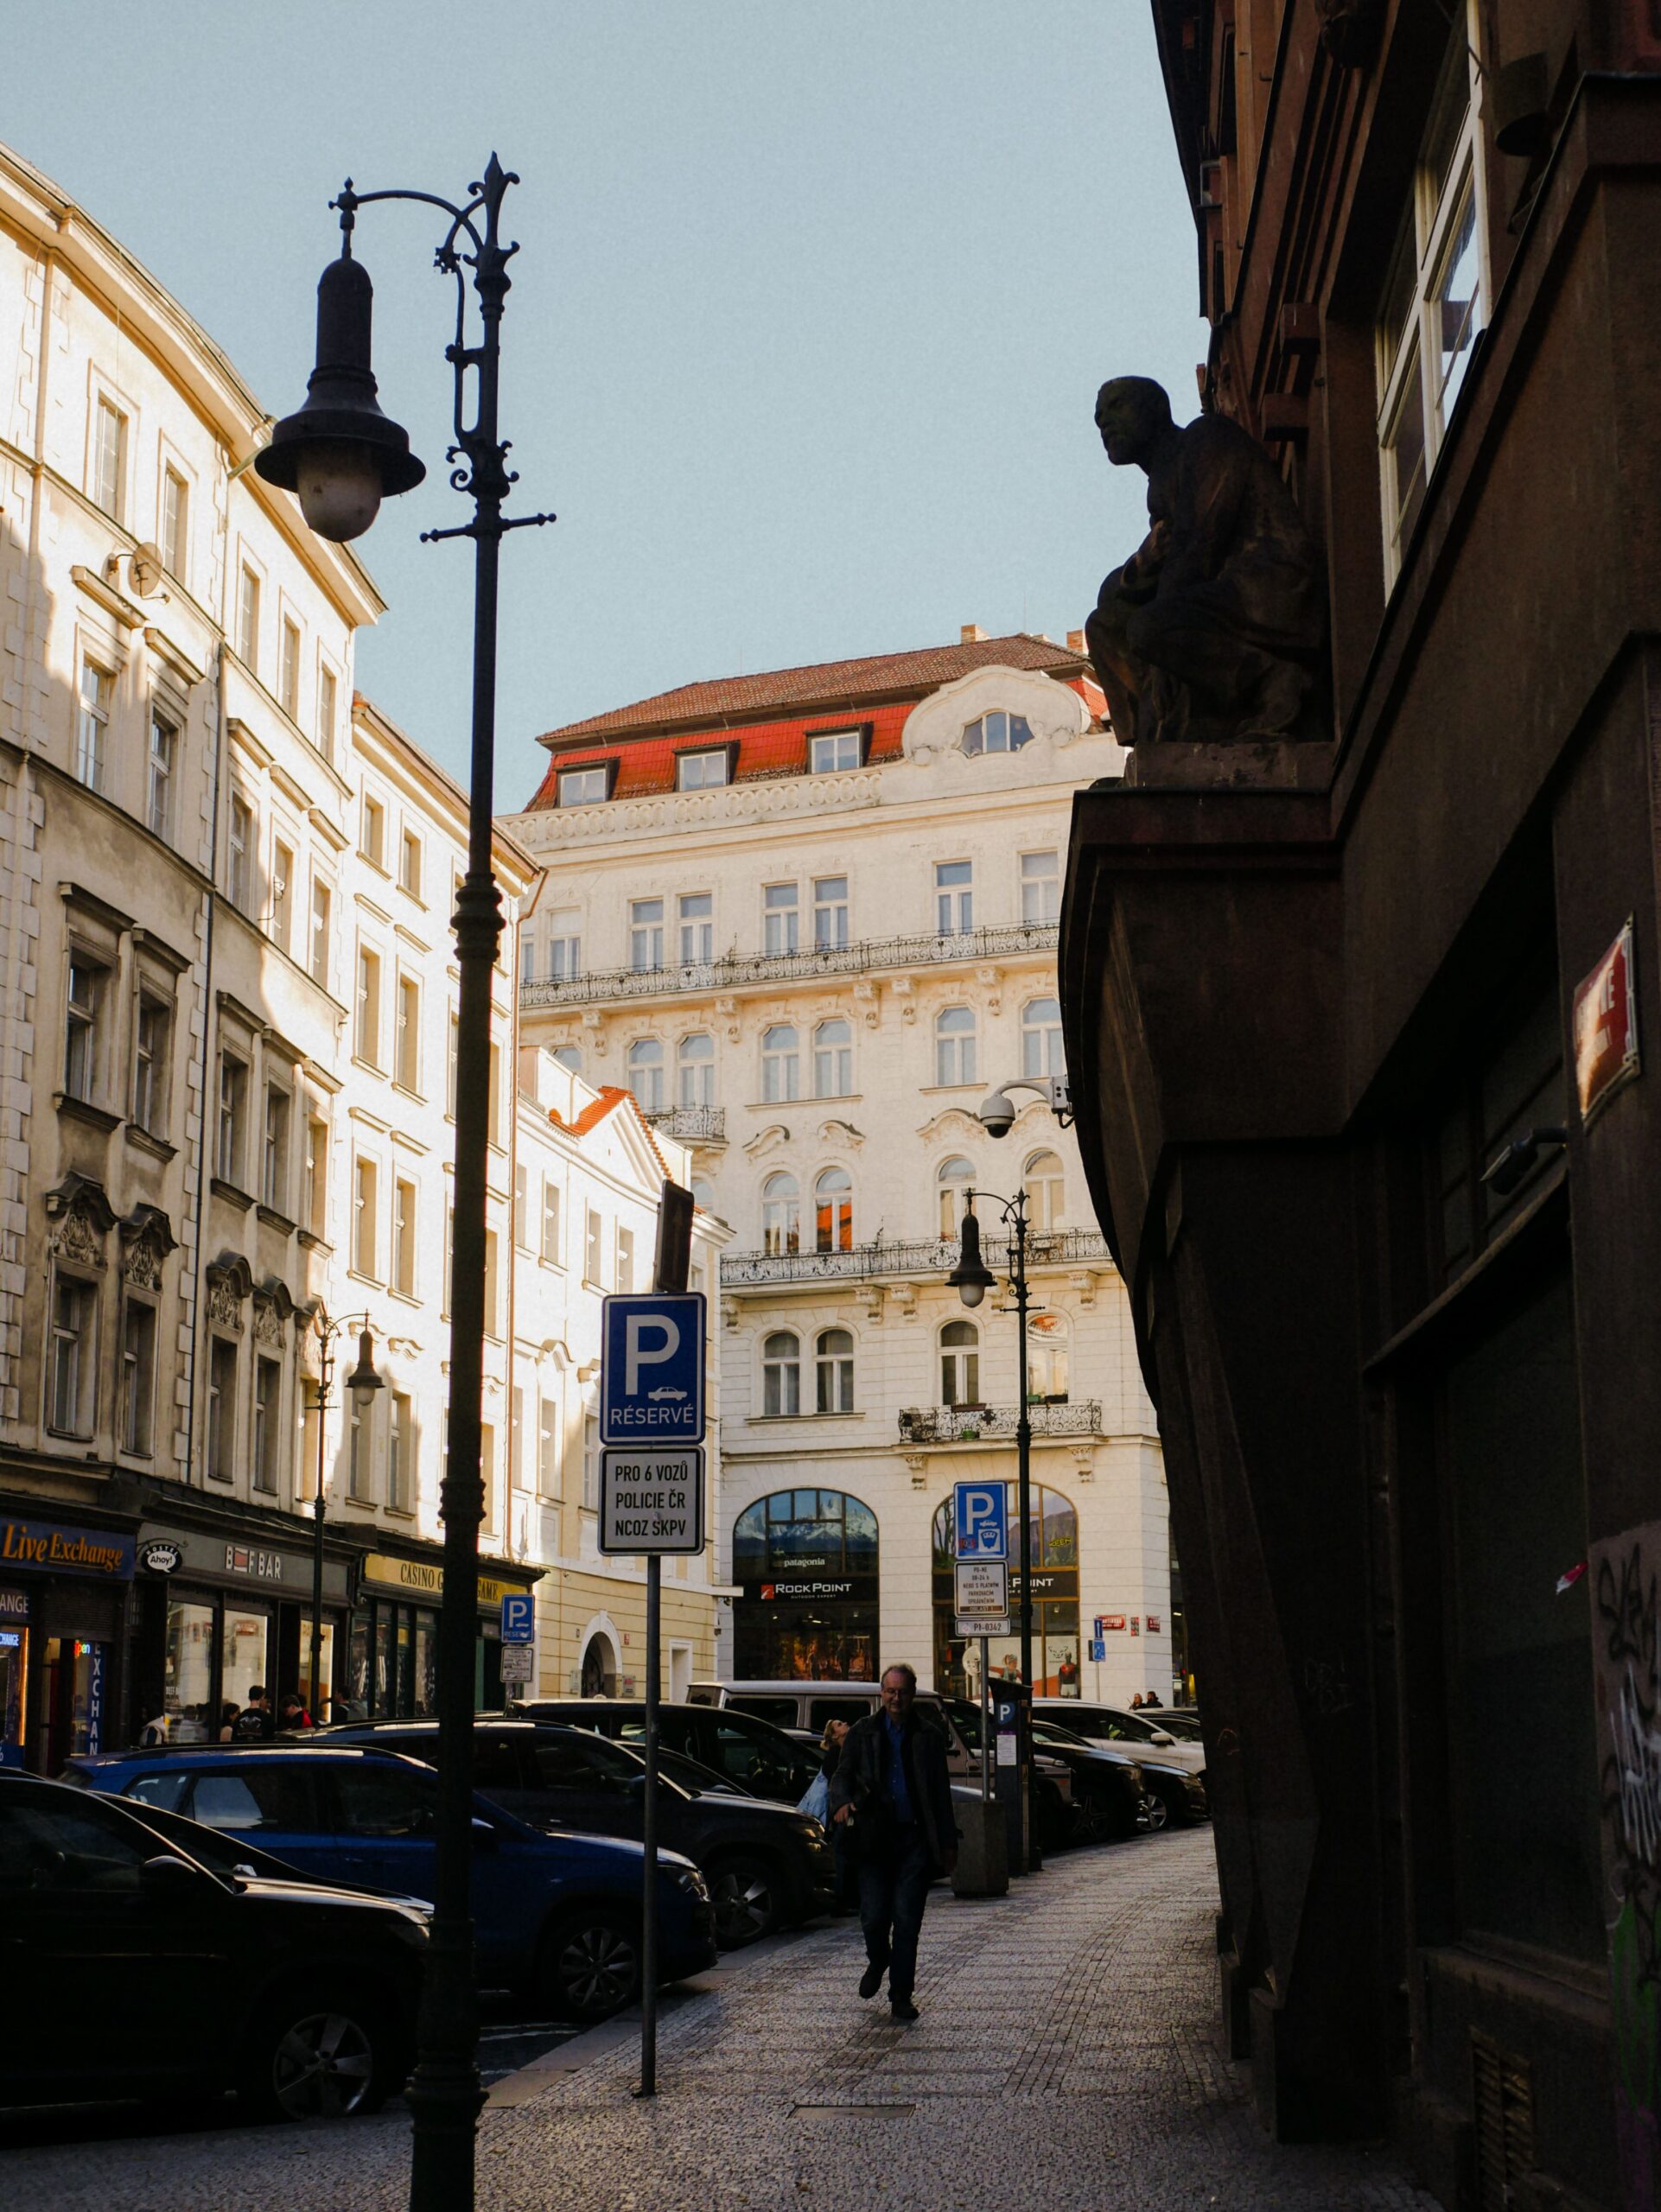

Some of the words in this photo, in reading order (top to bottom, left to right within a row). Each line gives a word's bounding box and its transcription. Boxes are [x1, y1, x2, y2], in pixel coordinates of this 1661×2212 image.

[625, 1313, 681, 1396] P
[610, 1403, 695, 1426] RÉSERVÉ
[614, 1465, 640, 1482] PRO
[644, 1464, 652, 1481] 6
[656, 1460, 689, 1481] VOZŮ
[615, 1491, 665, 1510] POLICIE
[668, 1488, 685, 1509] ČR
[965, 1491, 995, 1535] P
[614, 1521, 649, 1537] NCOZ
[652, 1519, 686, 1536] SKPV
[2, 1522, 48, 1563] Live
[48, 1533, 124, 1573] Exchange
[145, 1545, 179, 1556] HOSTEL
[150, 1554, 173, 1566] Ahoy!
[258, 1552, 282, 1580] BAR
[784, 1557, 826, 1567] patagonia
[400, 1563, 435, 1588] CASINO
[1012, 1577, 1054, 1587] PINT
[0, 1592, 29, 1614] ANGE
[508, 1600, 528, 1628] P
[999, 1704, 1011, 1722] P
